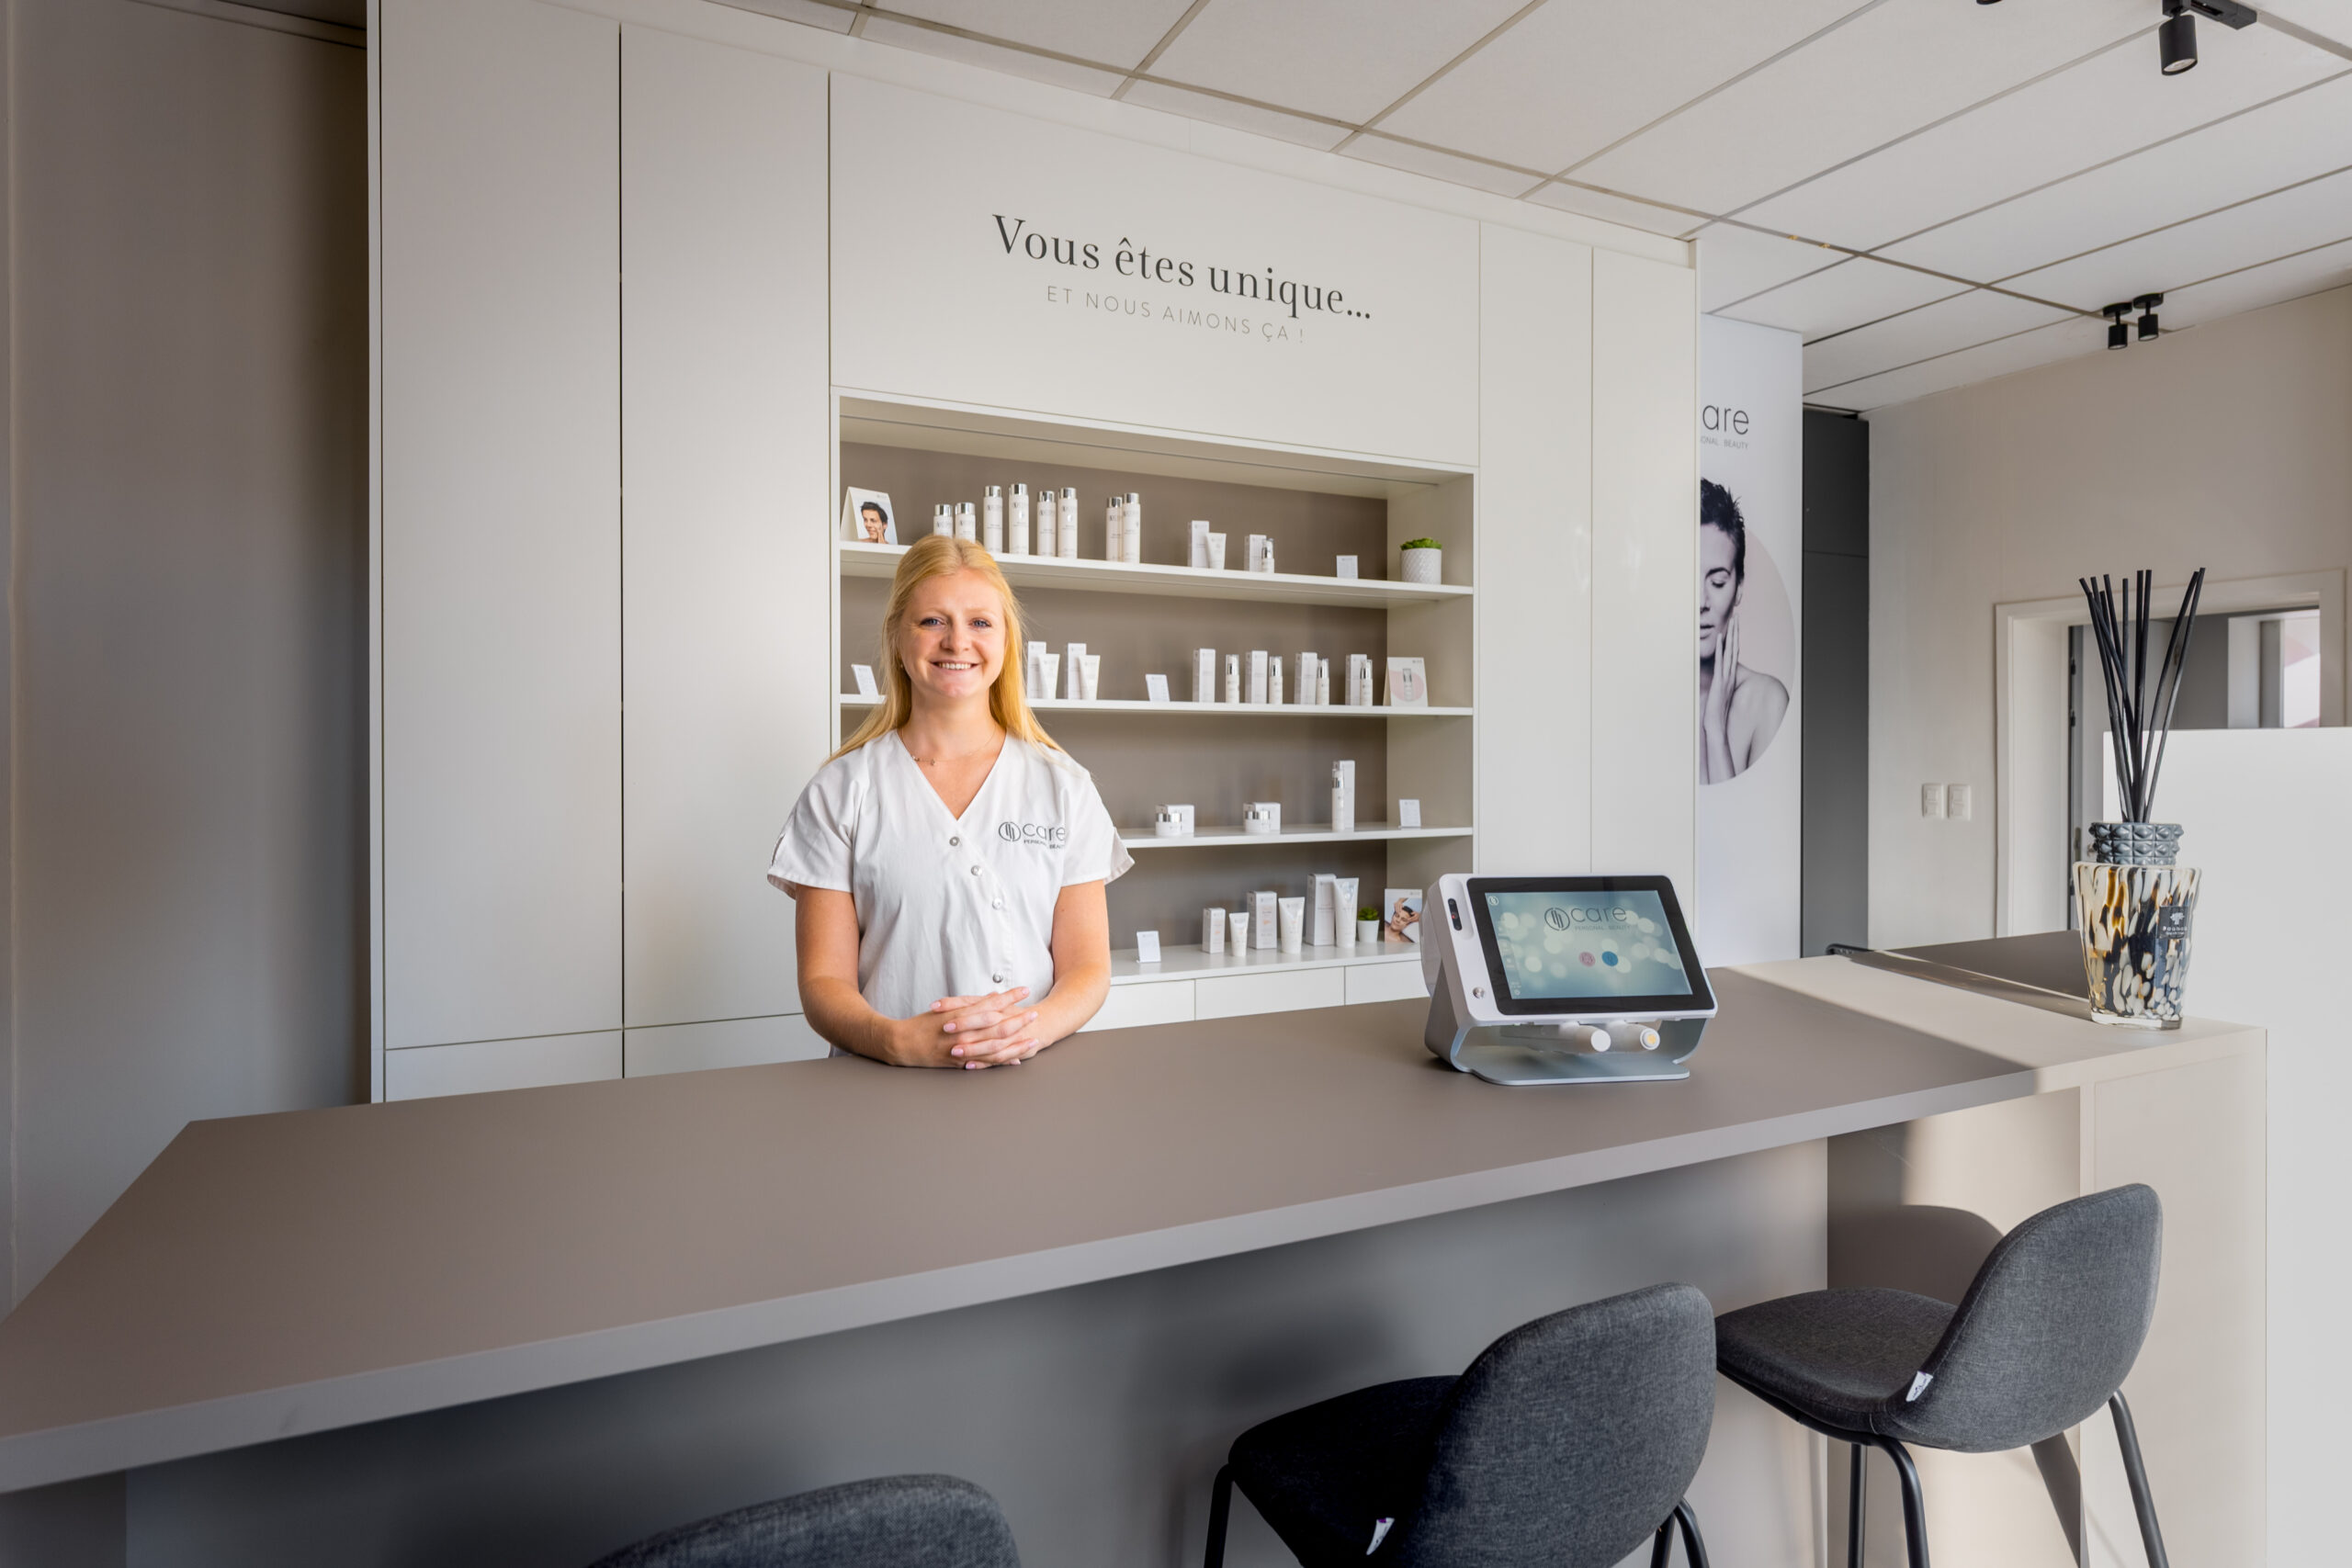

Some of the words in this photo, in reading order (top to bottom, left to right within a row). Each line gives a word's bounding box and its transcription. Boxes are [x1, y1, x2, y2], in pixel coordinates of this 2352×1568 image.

[991, 213, 1100, 270] Vous
[1114, 236, 1194, 288] êtes
[1207, 266, 1371, 319] unique...
[1047, 286, 1073, 304] ET
[1085, 292, 1151, 318] NOUS
[1161, 305, 1250, 334] AIMONS
[1261, 322, 1288, 343] ÇA
[1022, 823, 1066, 841] care
[1571, 908, 1627, 922] care
